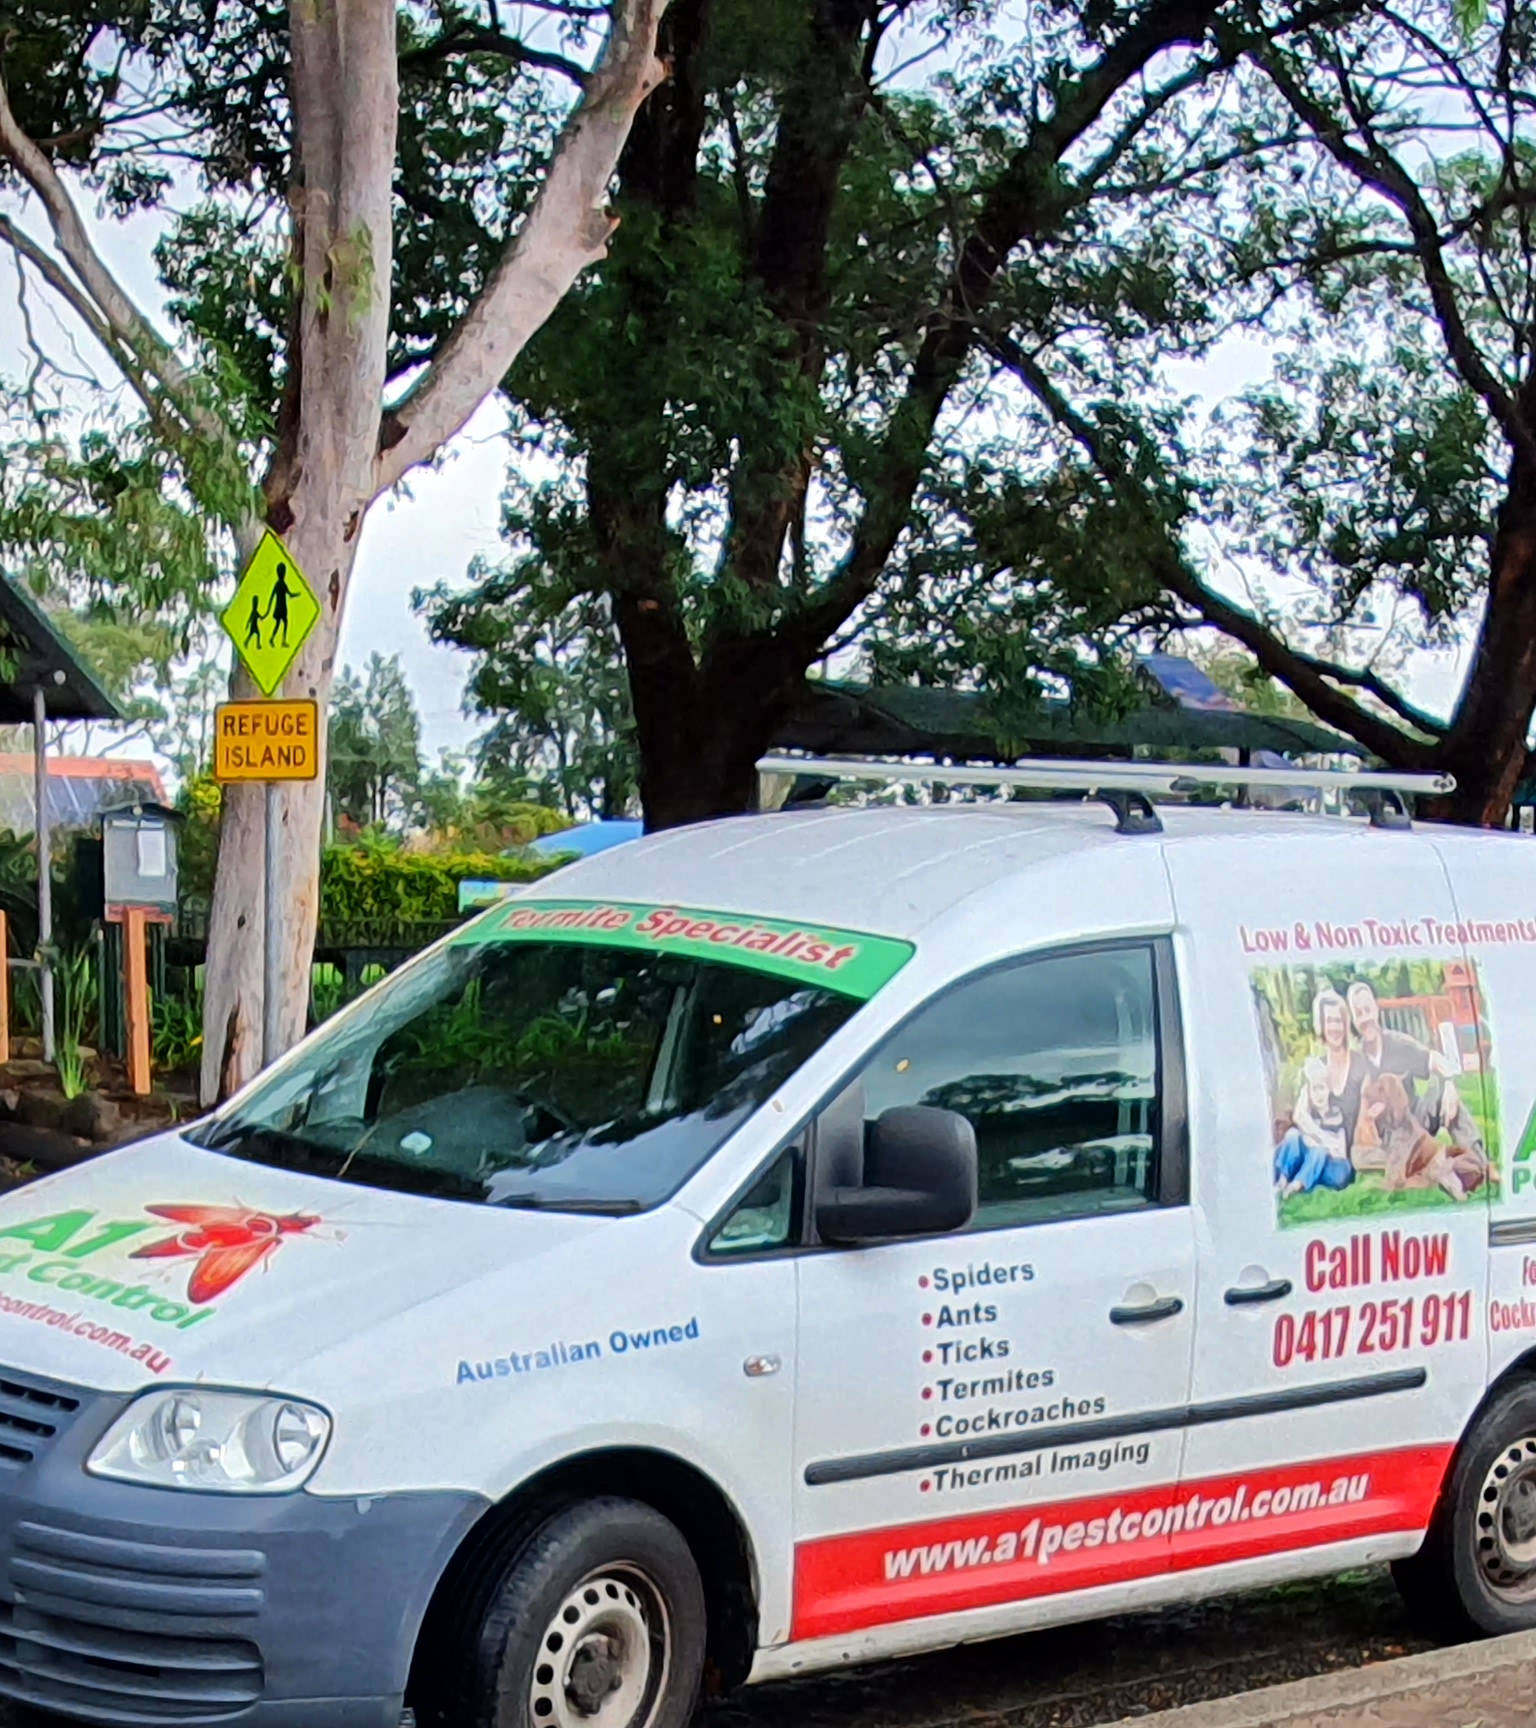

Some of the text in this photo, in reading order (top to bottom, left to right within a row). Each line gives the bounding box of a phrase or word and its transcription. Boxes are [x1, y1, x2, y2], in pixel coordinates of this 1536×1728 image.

[222, 712, 309, 738] REFUGE
[223, 743, 307, 769] ISLAND
[500, 906, 857, 970] Termite Specialist
[1239, 923, 1288, 952] Low
[1294, 922, 1311, 950] &
[1315, 920, 1363, 949] Non
[1363, 918, 1422, 946] Toxic
[932, 1262, 1035, 1295] Spiders
[1305, 1229, 1450, 1293] Call Now
[27, 1259, 216, 1330] Control
[936, 1302, 998, 1329] Ants
[1273, 1288, 1472, 1368] 0417 251 911
[455, 1316, 702, 1386] Australian Owned
[936, 1337, 1010, 1366] Ticks
[936, 1368, 1055, 1402] Termites
[935, 1396, 1106, 1437] Cockroaches
[933, 1441, 1151, 1493] Thermal Imaging
[883, 1472, 1371, 1581] www.a1pestcontrol.com.au
